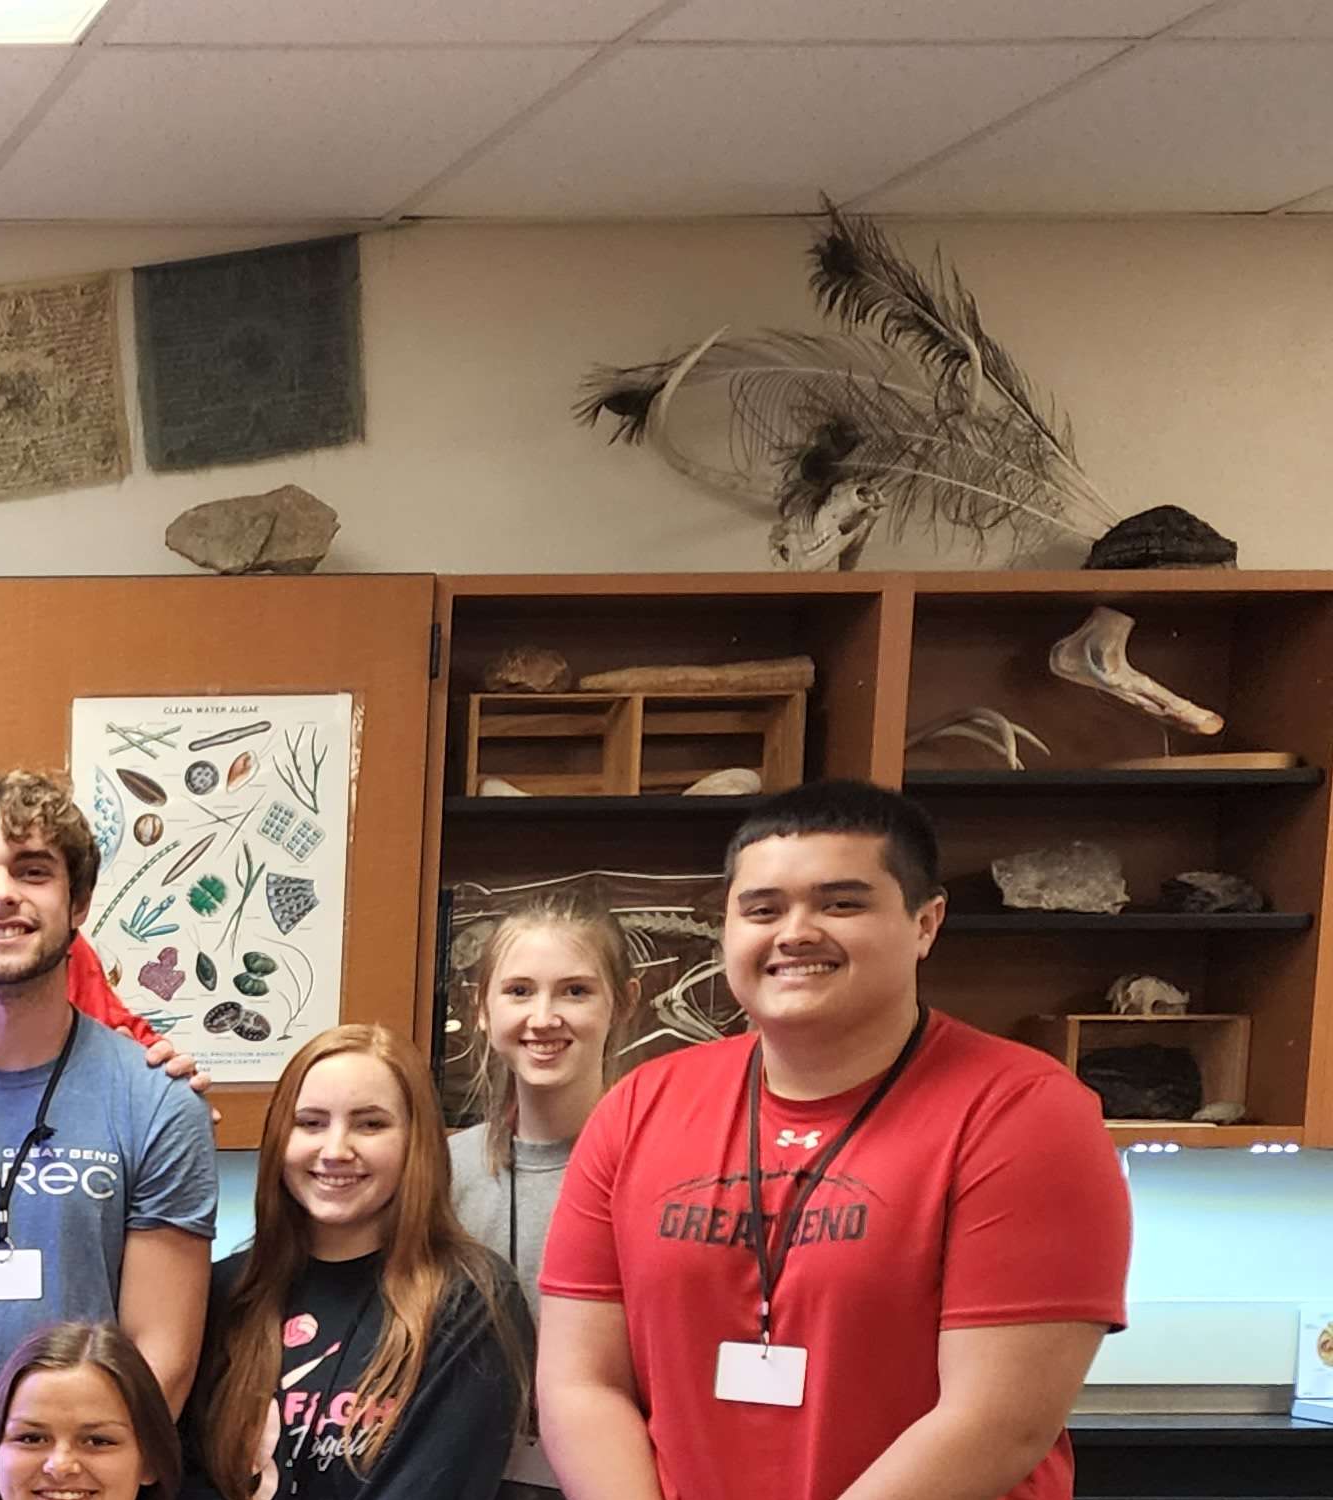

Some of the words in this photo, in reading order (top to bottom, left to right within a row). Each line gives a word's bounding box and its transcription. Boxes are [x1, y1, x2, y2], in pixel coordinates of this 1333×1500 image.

[162, 705, 193, 715] CLEAN
[196, 705, 228, 715] WATER
[229, 704, 260, 714] ALGAE
[2, 1148, 65, 1160] GEAT
[68, 1149, 120, 1164] BEND
[792, 1203, 868, 1246] END
